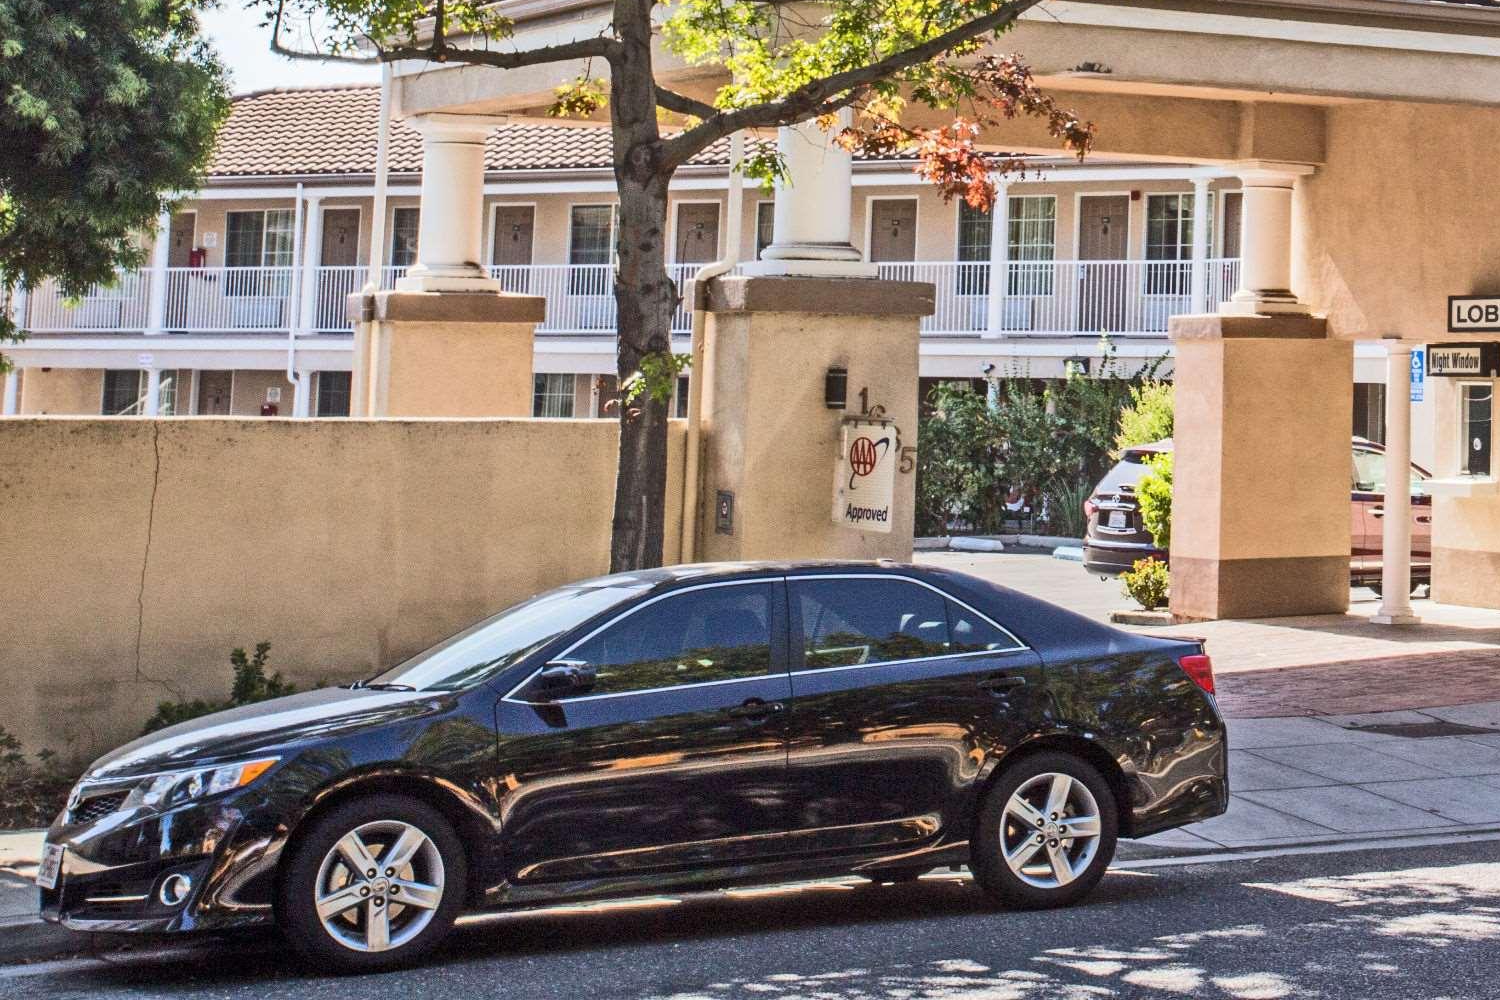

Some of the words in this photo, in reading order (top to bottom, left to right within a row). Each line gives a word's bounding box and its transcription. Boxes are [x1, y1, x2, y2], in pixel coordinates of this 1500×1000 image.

[1431, 352, 1450, 371] Night
[1451, 352, 1480, 368] Window
[851, 439, 875, 475] AAA
[846, 503, 888, 523] Approved
